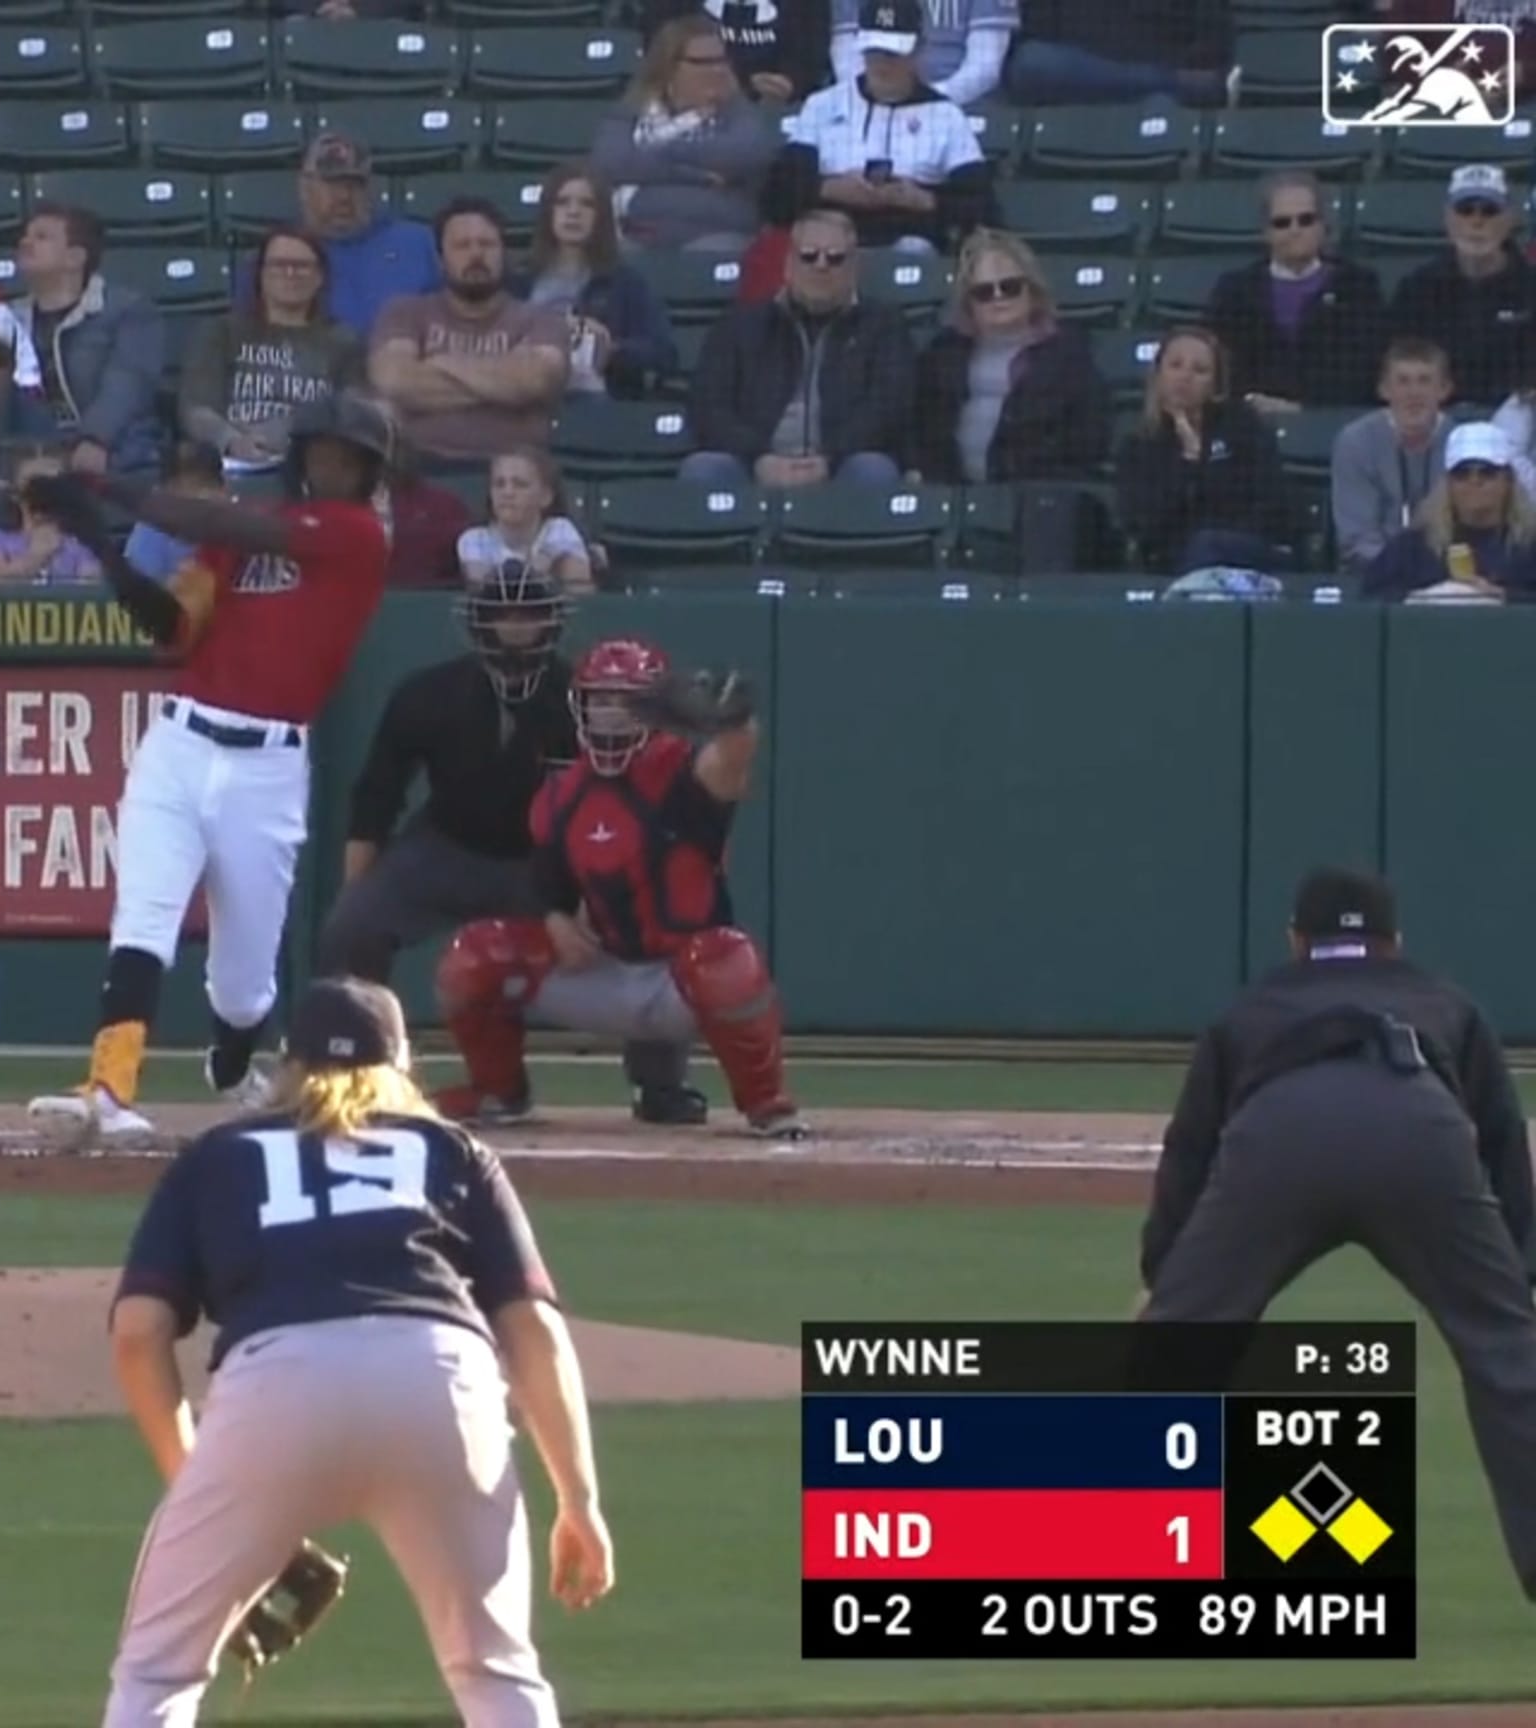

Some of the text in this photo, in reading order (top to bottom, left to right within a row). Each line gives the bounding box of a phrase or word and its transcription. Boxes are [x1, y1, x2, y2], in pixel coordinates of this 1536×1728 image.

[233, 371, 276, 401] FAIR
[3, 804, 118, 889] FAN
[240, 1127, 429, 1229] 19
